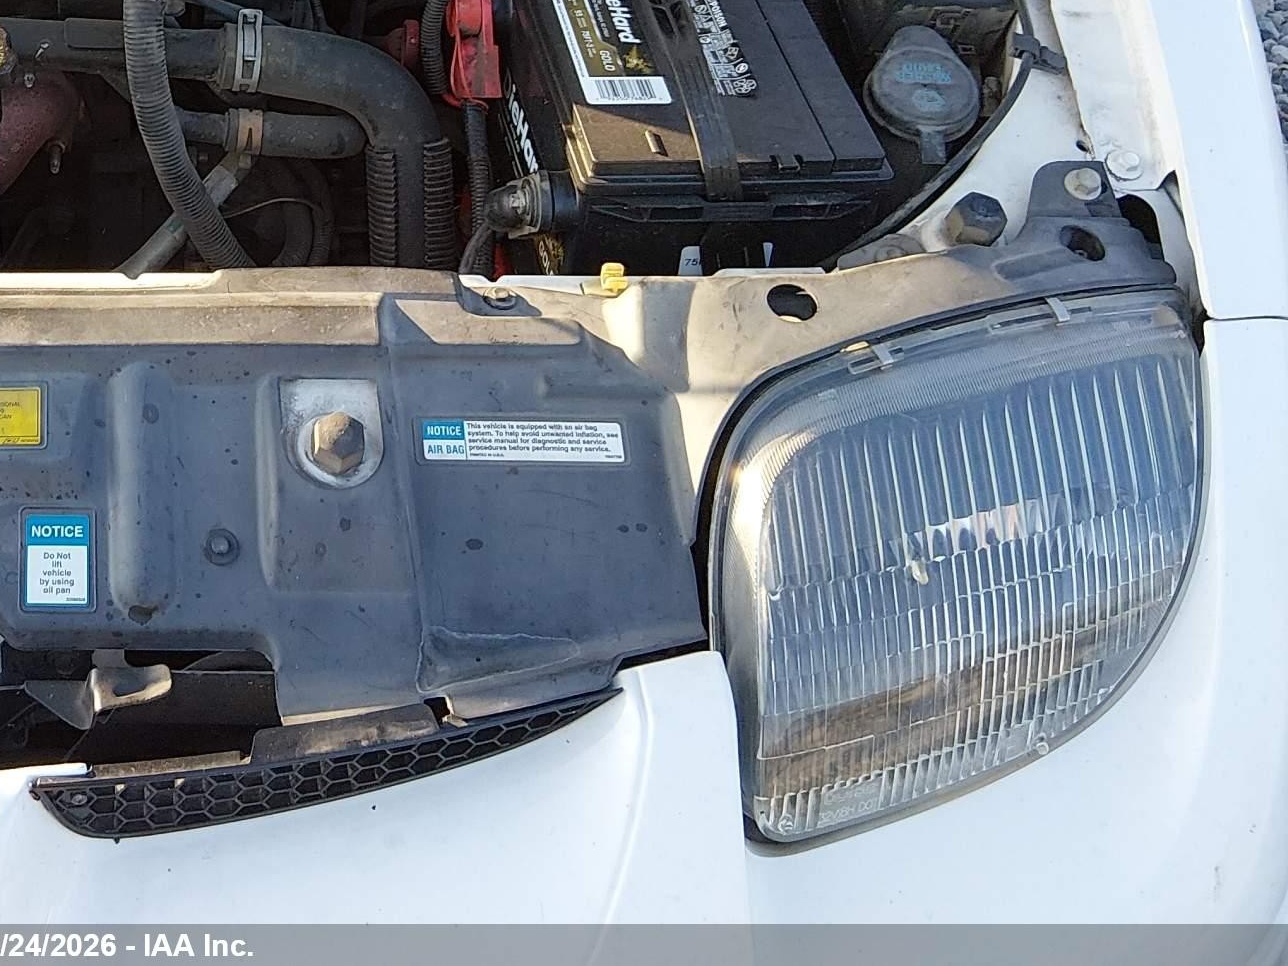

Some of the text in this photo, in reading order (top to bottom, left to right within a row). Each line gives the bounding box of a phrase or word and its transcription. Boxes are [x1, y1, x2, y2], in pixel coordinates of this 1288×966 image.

[600, 50, 615, 72] GOLD
[504, 68, 539, 173] DieHar
[427, 425, 461, 436] NOTICE
[468, 431, 493, 439] system.
[506, 430, 519, 438] help
[532, 437, 566, 445] diagnostic
[428, 445, 464, 454] AIR BAG
[32, 526, 83, 538] NOTICE
[40, 578, 49, 586] by
